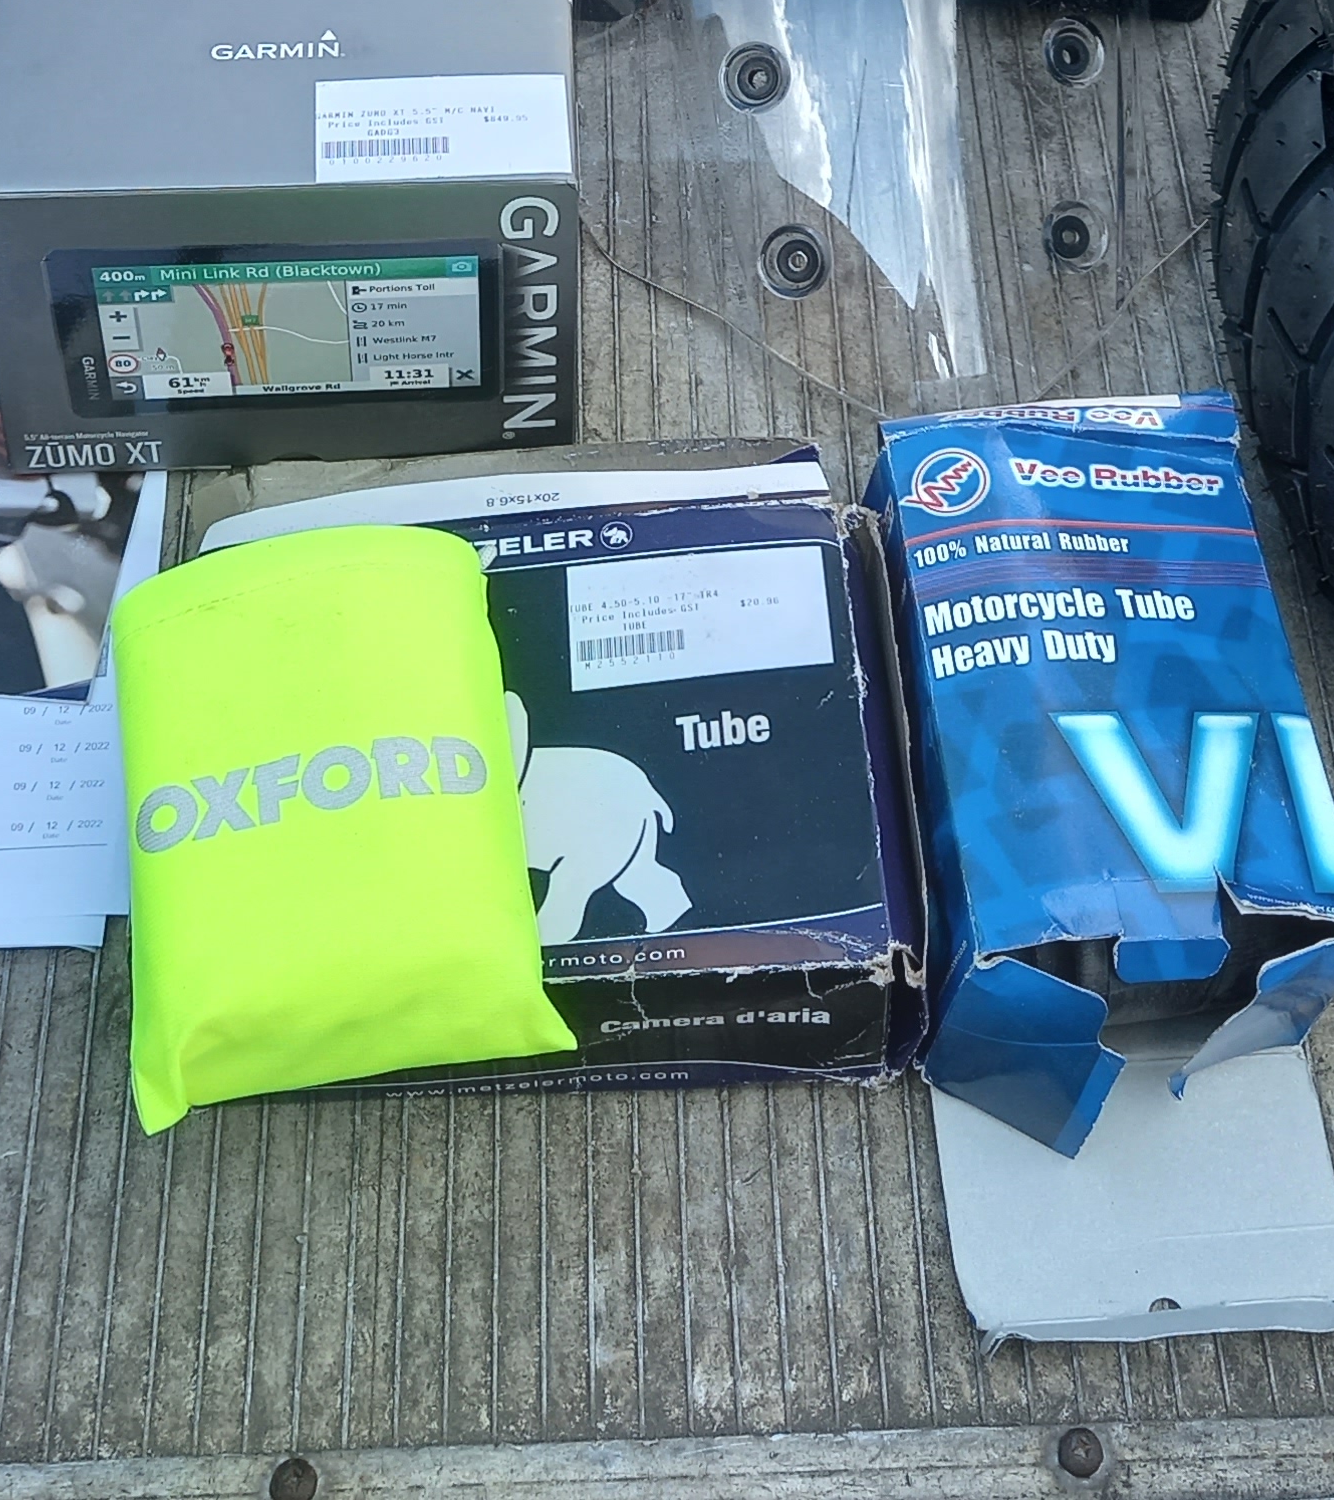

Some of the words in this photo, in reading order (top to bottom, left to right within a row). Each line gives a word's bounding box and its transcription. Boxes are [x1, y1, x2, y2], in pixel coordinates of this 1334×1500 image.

[211, 41, 339, 60] GARMIN
[361, 109, 386, 118] ZUMO
[393, 108, 405, 116] XT
[328, 121, 360, 129] Price
[368, 118, 418, 127] Includes
[100, 270, 146, 282] 400m
[160, 269, 197, 281] Mini
[204, 267, 242, 280] Link
[246, 266, 268, 278] Rd
[275, 263, 381, 278] (Blacktown)
[369, 284, 413, 293] Portions
[416, 283, 435, 291] Toll
[371, 303, 384, 311] 17
[388, 301, 407, 310] min
[500, 196, 559, 430] GARMIN
[371, 320, 385, 328] 20
[389, 319, 405, 327] km
[372, 336, 418, 344] Westlink
[421, 335, 437, 343] M7
[373, 353, 399, 362] Light
[402, 352, 433, 360] Horse
[115, 359, 132, 368] 80
[82, 356, 100, 400] GARMIN
[384, 368, 434, 380] 11:31
[168, 377, 194, 388] 61
[262, 383, 322, 393] Wallgrove
[325, 383, 341, 391] Rd
[76, 431, 114, 440] Motorcycle
[125, 441, 162, 465] XT
[1013, 461, 1082, 484] Vee
[1092, 466, 1222, 493] Rubber
[486, 492, 560, 507] 20x15x6.8
[914, 540, 967, 568] 100%
[975, 532, 1050, 554] Natural
[1060, 532, 1129, 553] Rubber
[582, 613, 615, 624] Price
[622, 606, 674, 620] Includes
[924, 588, 1106, 637] Motorcycle
[1115, 588, 1195, 620] Tube
[623, 620, 648, 631] TUBE
[931, 632, 1030, 679] Heavy
[1042, 629, 1116, 663] Duty
[24, 707, 36, 715] 09
[58, 706, 70, 714] 12
[88, 704, 113, 713] 2022
[675, 709, 771, 754] Tube
[19, 744, 32, 753] 09
[54, 743, 66, 752] 12
[84, 741, 110, 751] 2022
[13, 782, 27, 791] 09
[49, 781, 61, 789] 12
[80, 779, 105, 788] 2022
[135, 736, 488, 854] OXFORD
[10, 823, 24, 832] 09
[46, 821, 58, 830] 12
[78, 819, 103, 829] 2022
[599, 1014, 724, 1034] Camera
[736, 1007, 831, 1027] d'aria
[386, 1068, 690, 1098] www.metzelermoto.com
